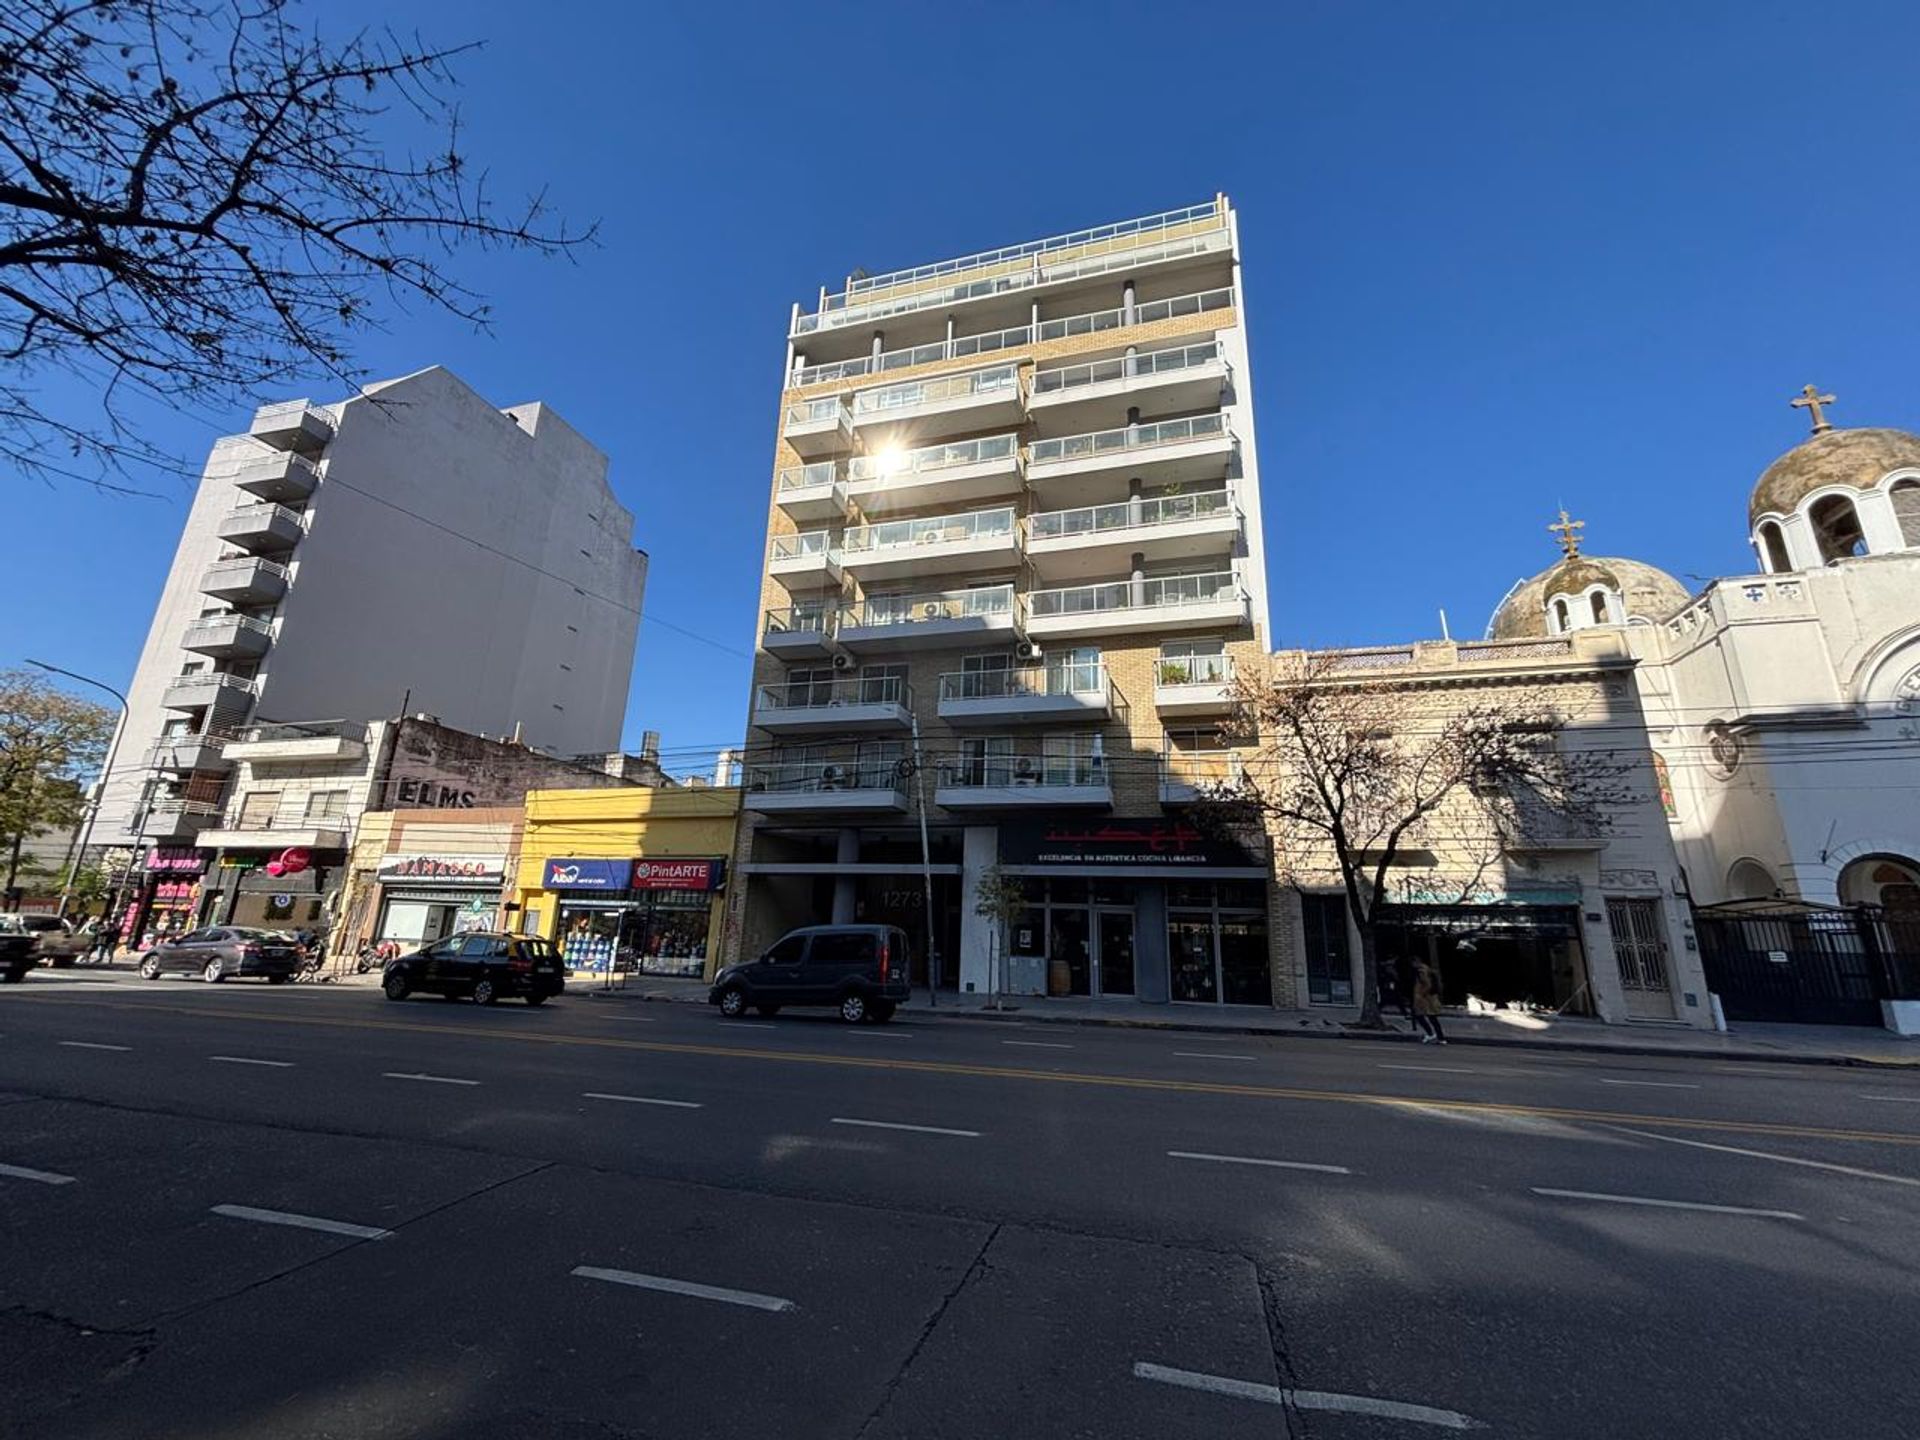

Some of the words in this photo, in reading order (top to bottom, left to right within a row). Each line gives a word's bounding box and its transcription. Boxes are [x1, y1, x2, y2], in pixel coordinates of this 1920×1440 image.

[1137, 855, 1167, 863] COCINA
[396, 862, 486, 876] DAMASCO
[651, 864, 707, 878] PintARTE
[883, 890, 922, 908] 1273
